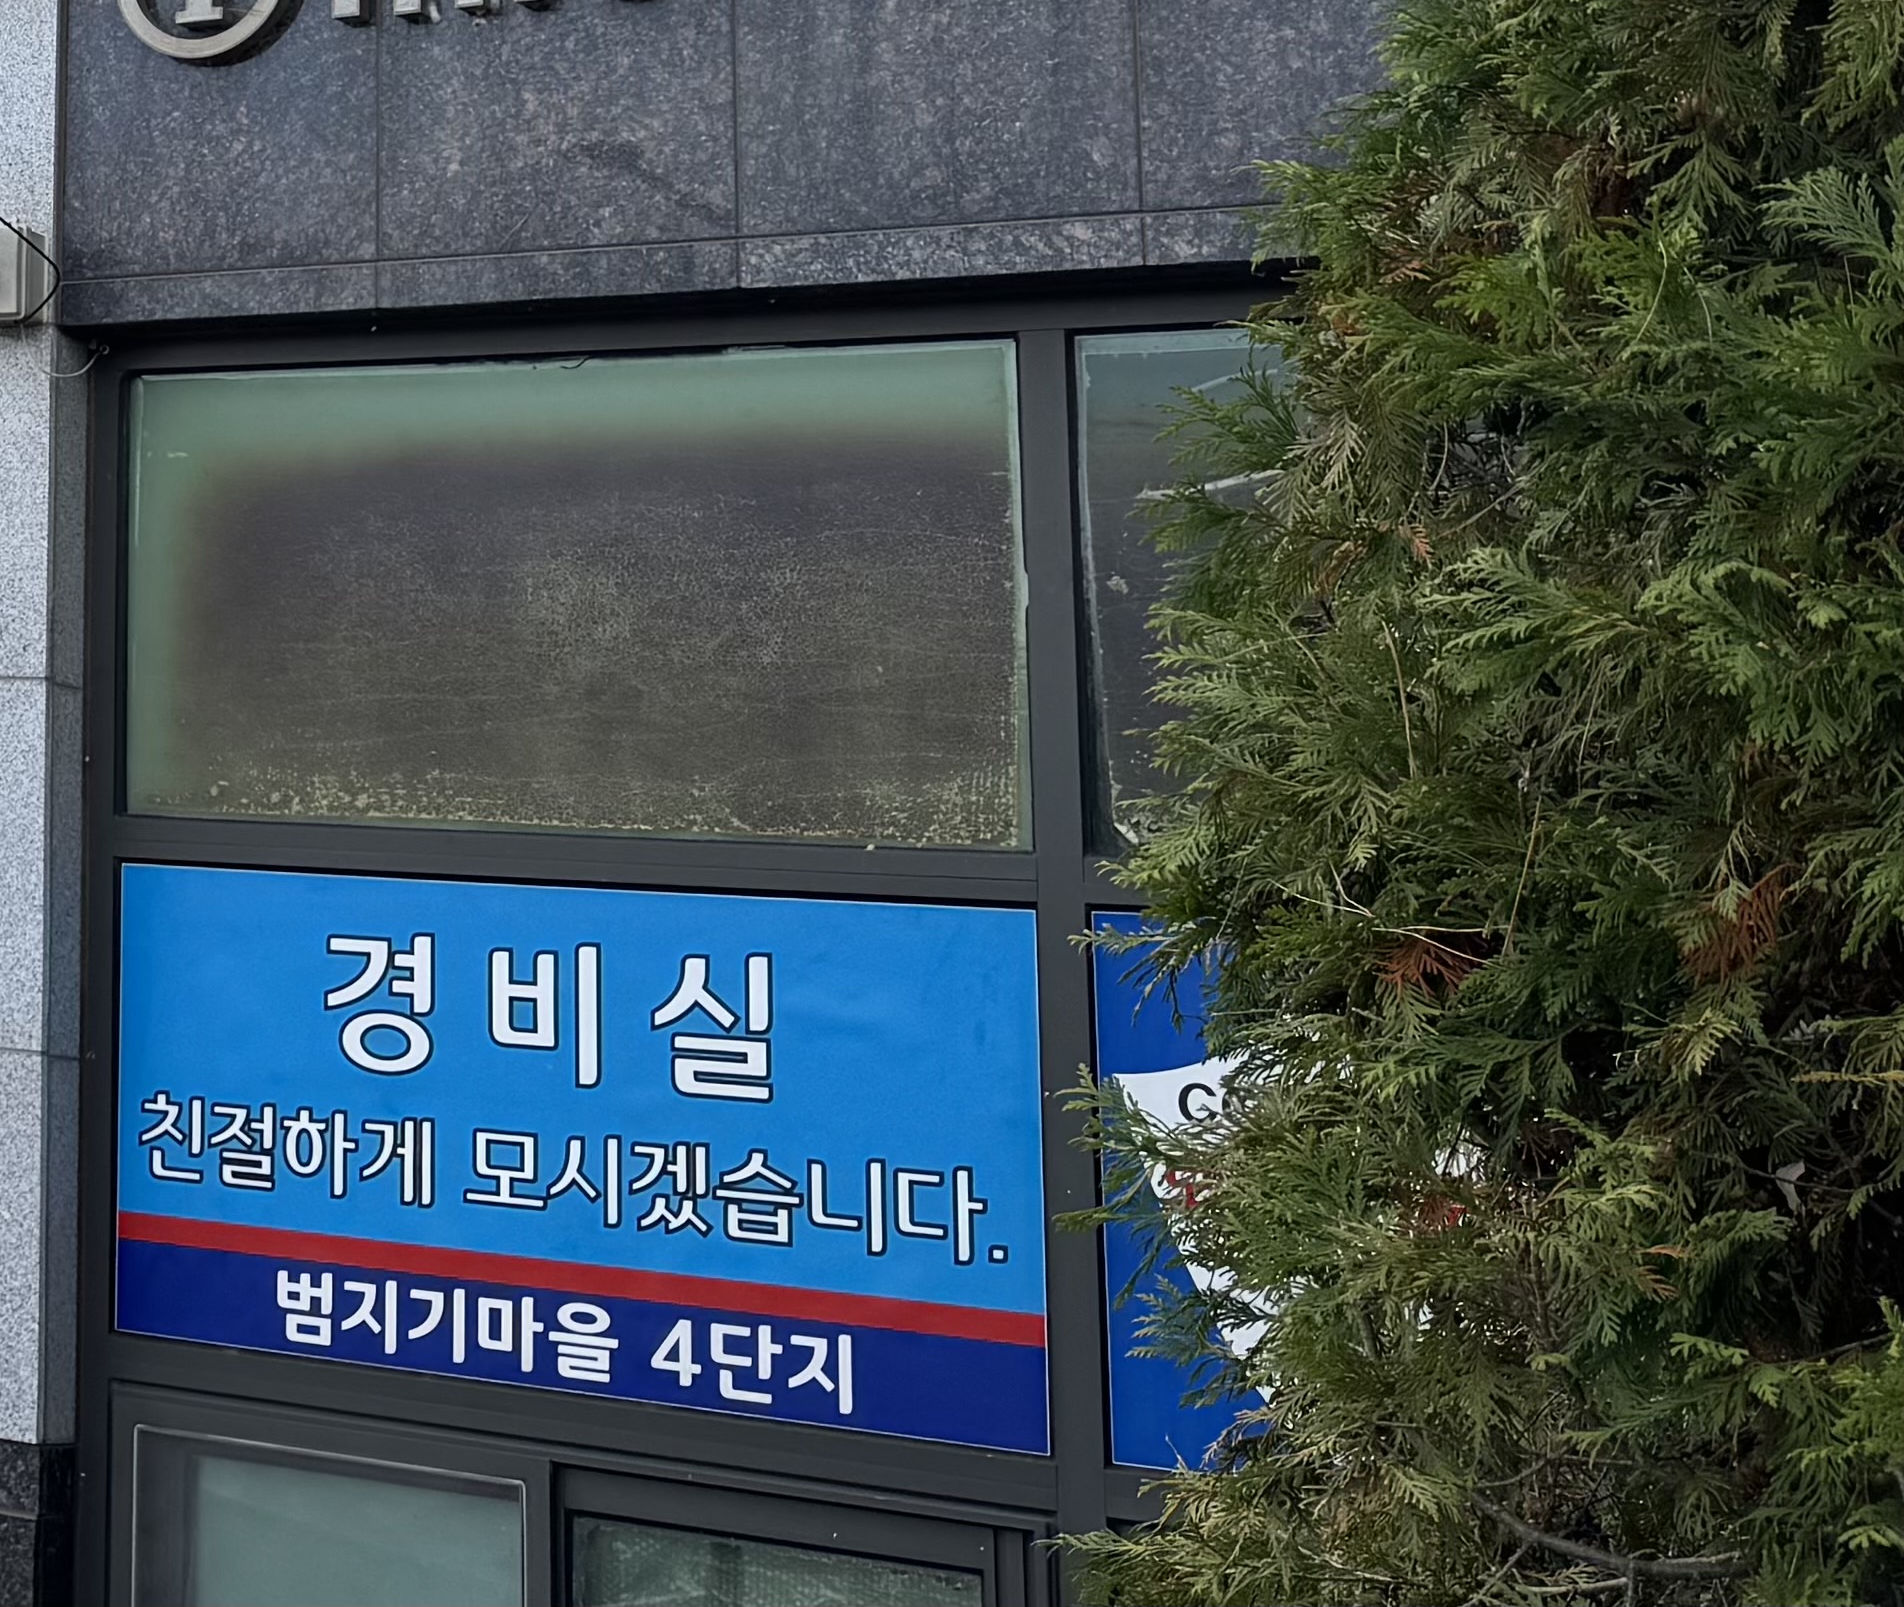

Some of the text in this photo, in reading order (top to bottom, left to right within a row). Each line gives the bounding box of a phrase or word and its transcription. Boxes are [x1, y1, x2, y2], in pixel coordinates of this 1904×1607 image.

[138, 1091, 1010, 1266] 친절하게 모시겠습니다.
[274, 1269, 854, 1416] 범지기마을 4단지
